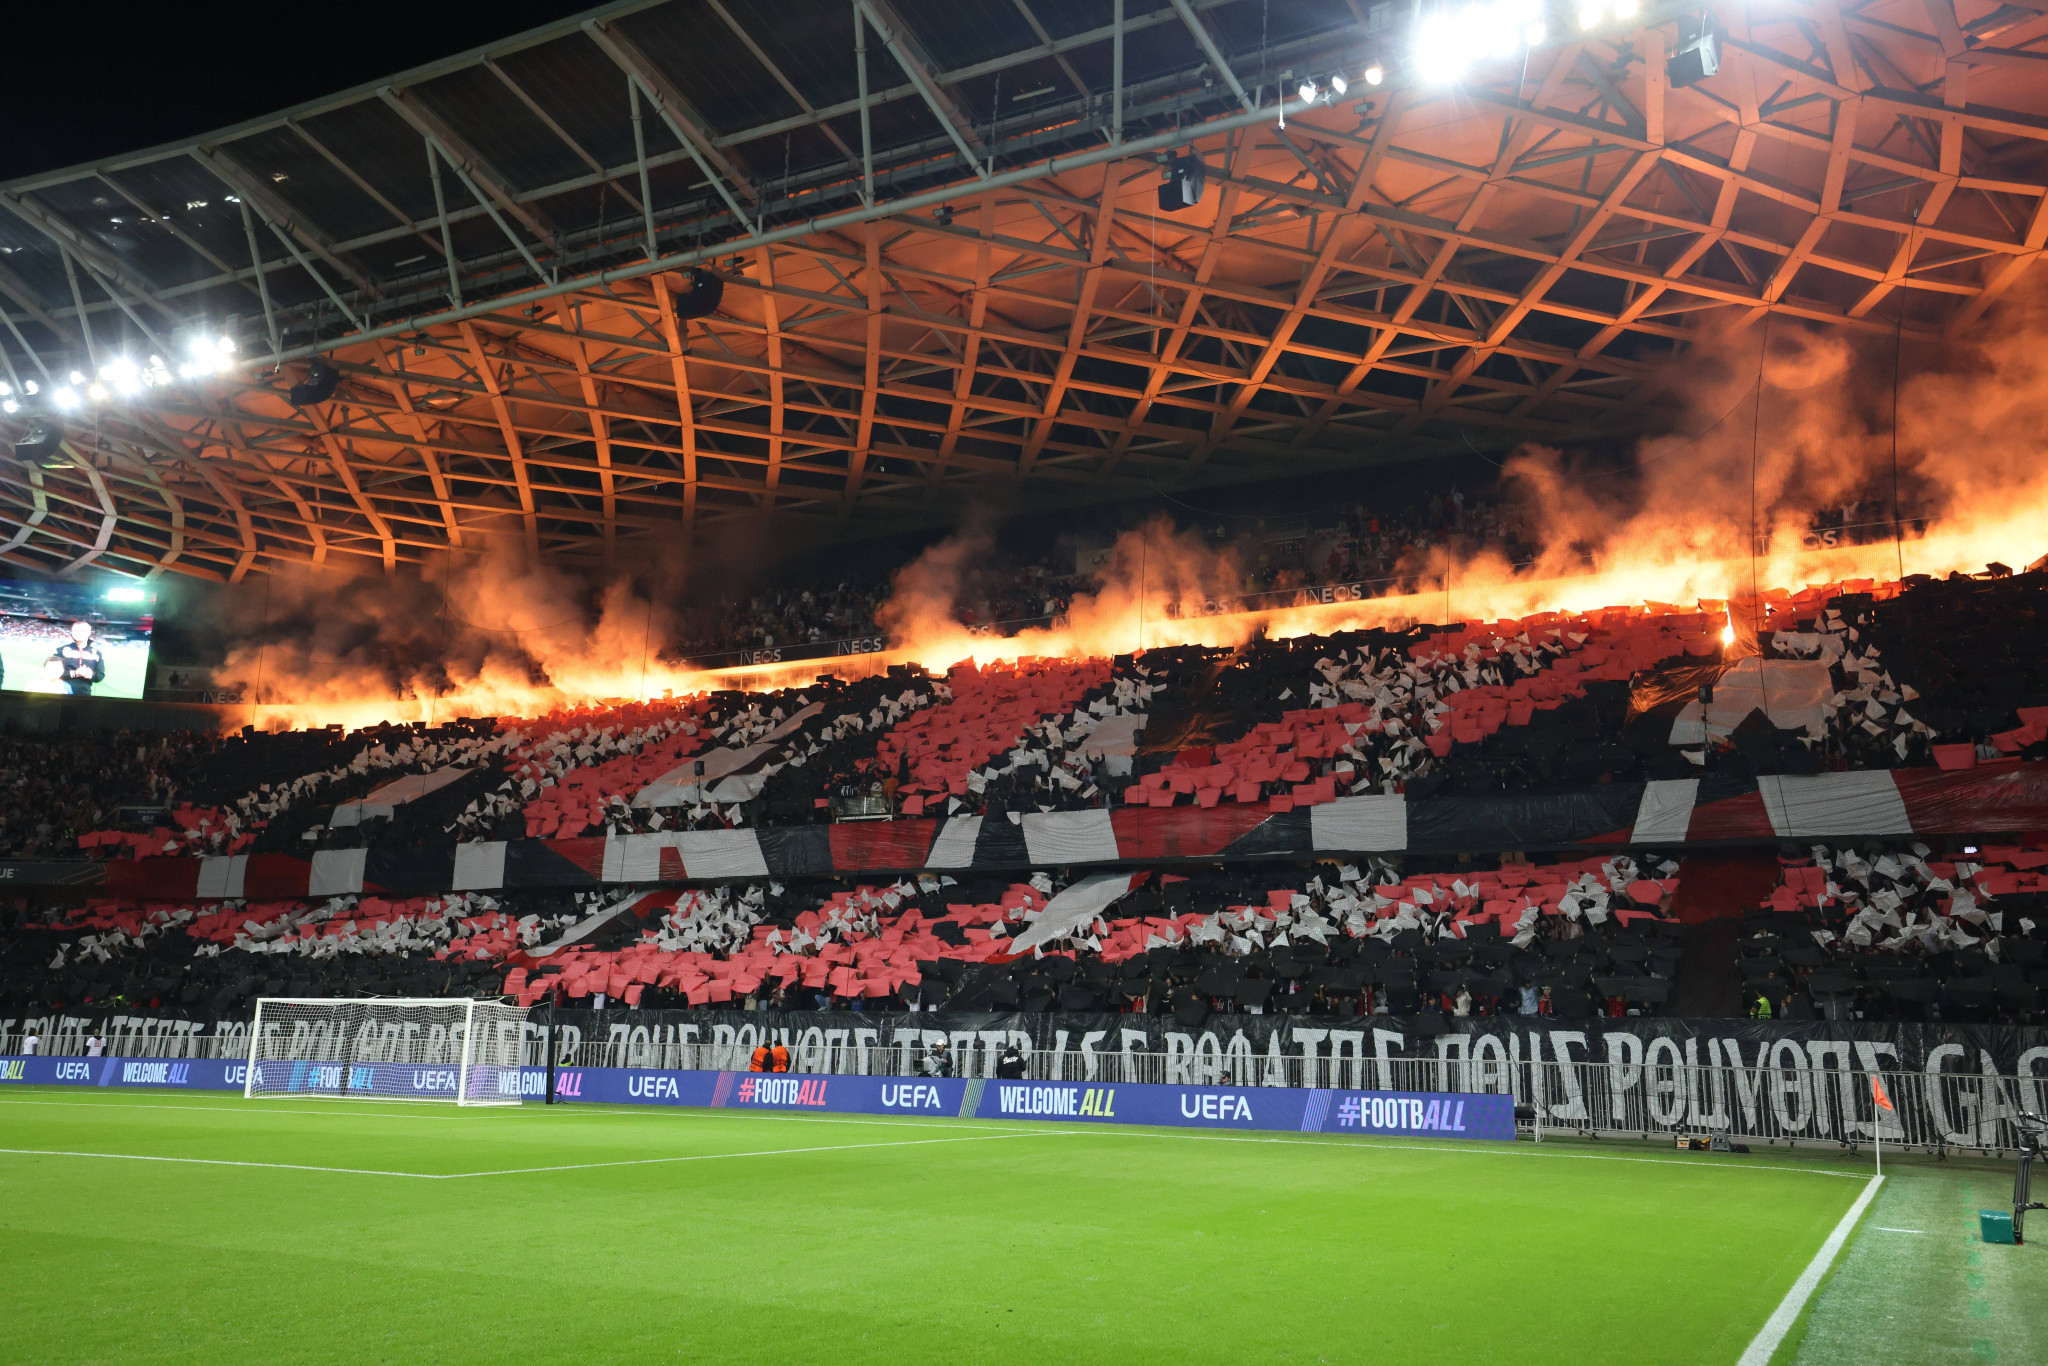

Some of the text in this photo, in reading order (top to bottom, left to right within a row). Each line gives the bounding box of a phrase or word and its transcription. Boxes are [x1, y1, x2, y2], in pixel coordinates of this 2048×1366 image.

[1304, 584, 1362, 605] INEOS
[739, 648, 782, 665] INEOS
[837, 637, 882, 656] INEOS
[56, 1062, 90, 1080] UEFA
[122, 1062, 190, 1084] WELCOME ALL
[413, 1070, 456, 1090] UEFA
[555, 1072, 582, 1097] ALL
[628, 1075, 680, 1099] UEFA
[738, 1077, 828, 1106] #FOOTBALL
[881, 1083, 942, 1109] UEFA
[1000, 1085, 1115, 1117] WELCOME ALL
[1181, 1092, 1253, 1121] UEFA
[1337, 1096, 1467, 1132] #FOOTBALL
